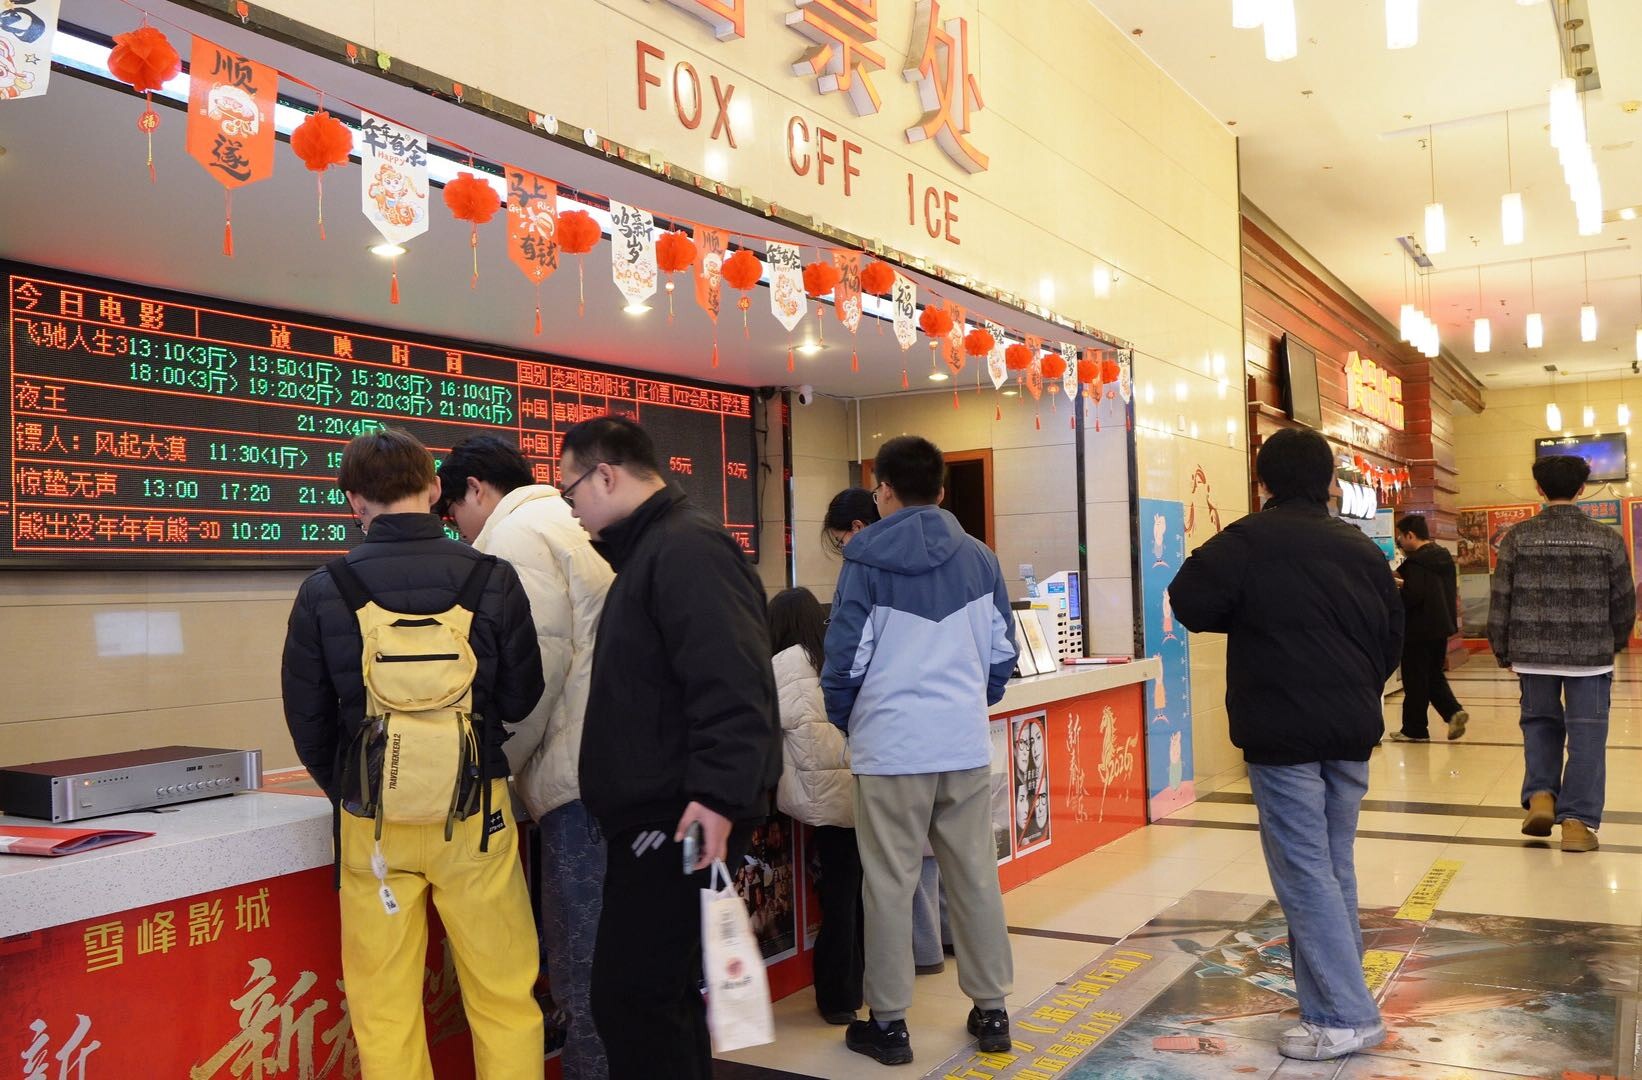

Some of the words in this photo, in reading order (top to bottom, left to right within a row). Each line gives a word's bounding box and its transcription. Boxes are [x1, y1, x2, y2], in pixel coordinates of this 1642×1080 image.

[660, 0, 989, 173] 票处
[908, 173, 960, 245] ICE
[14, 282, 164, 330] 今日电影
[15, 317, 127, 357] 飞驰人生3
[519, 363, 548, 386] 国别
[552, 369, 579, 392] 类型
[607, 375, 630, 397] 时长
[16, 381, 67, 412] 夜王
[638, 382, 672, 405] 正价票
[521, 397, 548, 420] 中国
[522, 433, 549, 455] 中国
[669, 456, 692, 475] 55元
[727, 462, 748, 479] 52元
[16, 467, 118, 499] 惊蛰无声
[143, 479, 198, 498] 13:00
[220, 483, 271, 503] 17:20
[299, 487, 345, 505] 21:40
[232, 523, 281, 541] 10:20
[301, 525, 346, 542] 12:30
[731, 532, 749, 548] 7元
[84, 887, 271, 973] 雪峰影城
[190, 957, 362, 1080] 新
